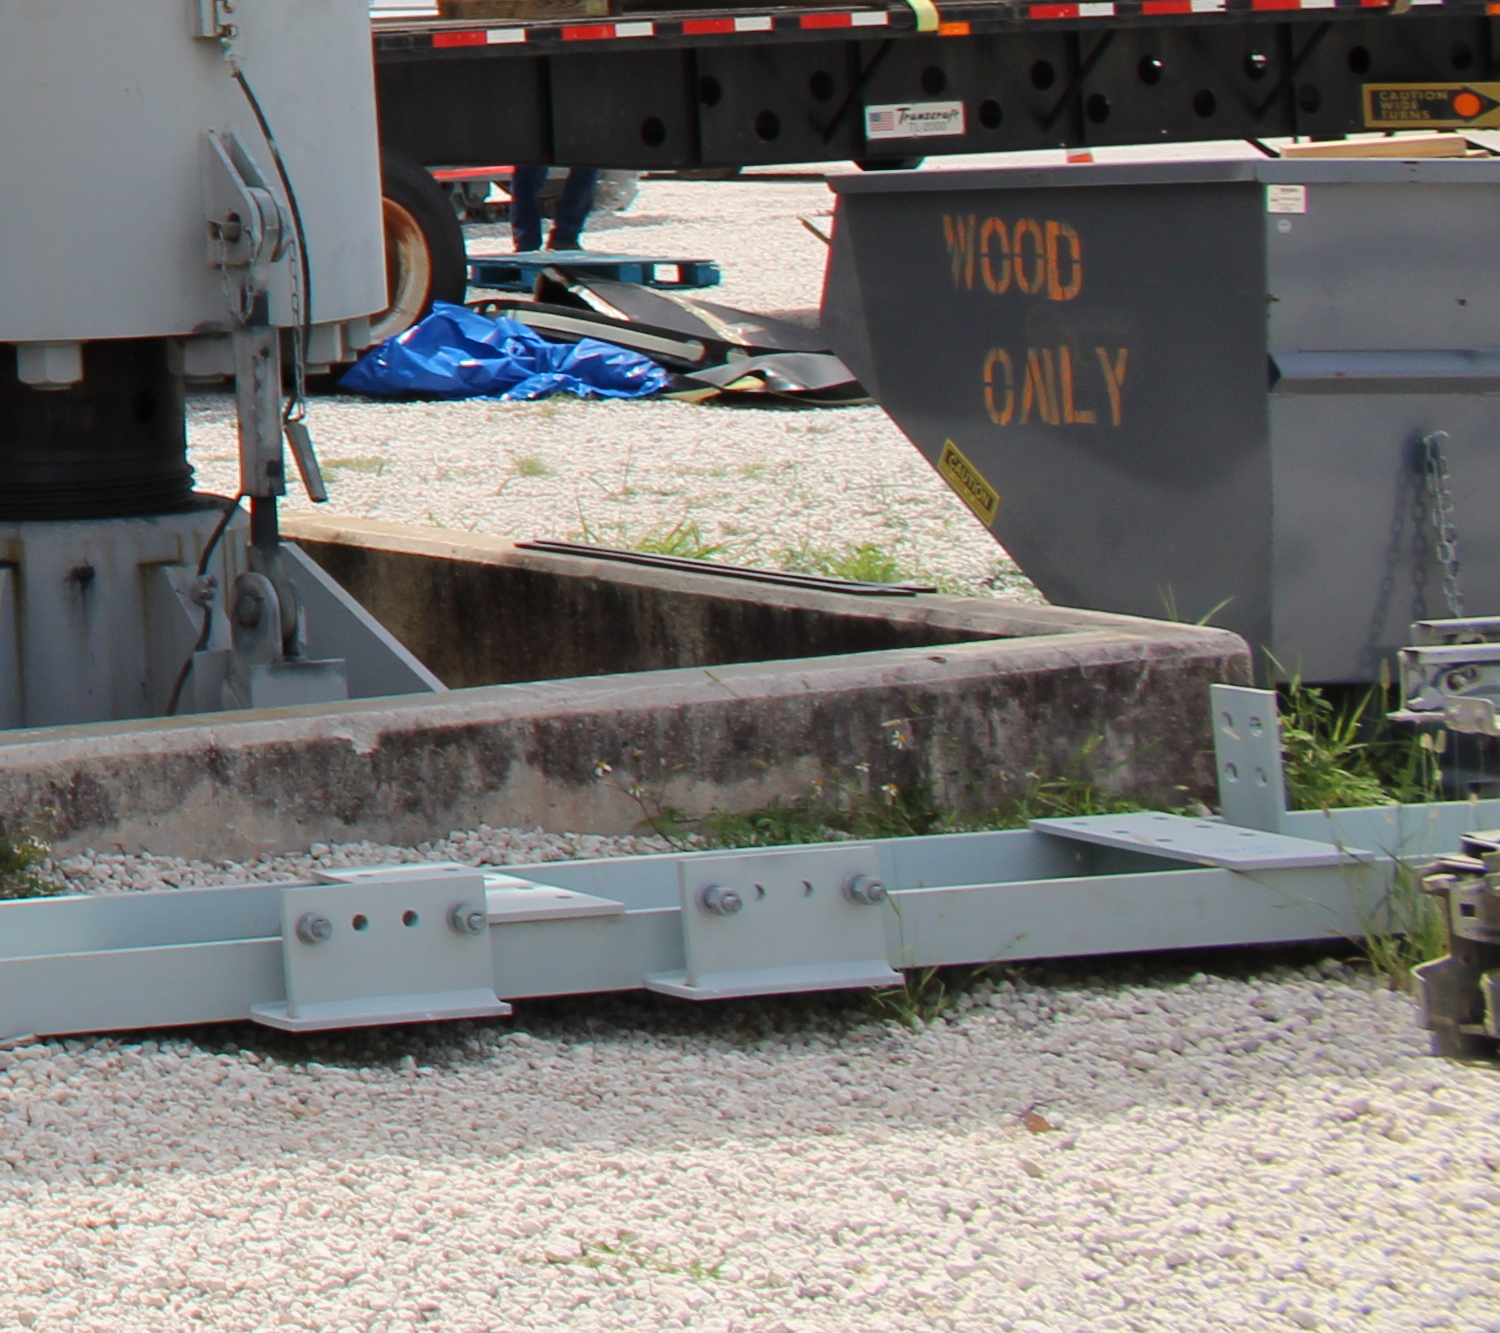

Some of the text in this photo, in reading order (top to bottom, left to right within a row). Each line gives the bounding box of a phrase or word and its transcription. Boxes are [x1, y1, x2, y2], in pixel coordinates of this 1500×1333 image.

[1378, 90, 1450, 101] CAUTION
[1379, 100, 1419, 111] WIDE
[1379, 110, 1432, 121] TURNS
[942, 214, 1083, 301] WOOD
[983, 346, 1128, 427] ONLY
[948, 454, 992, 507] CAUTION
